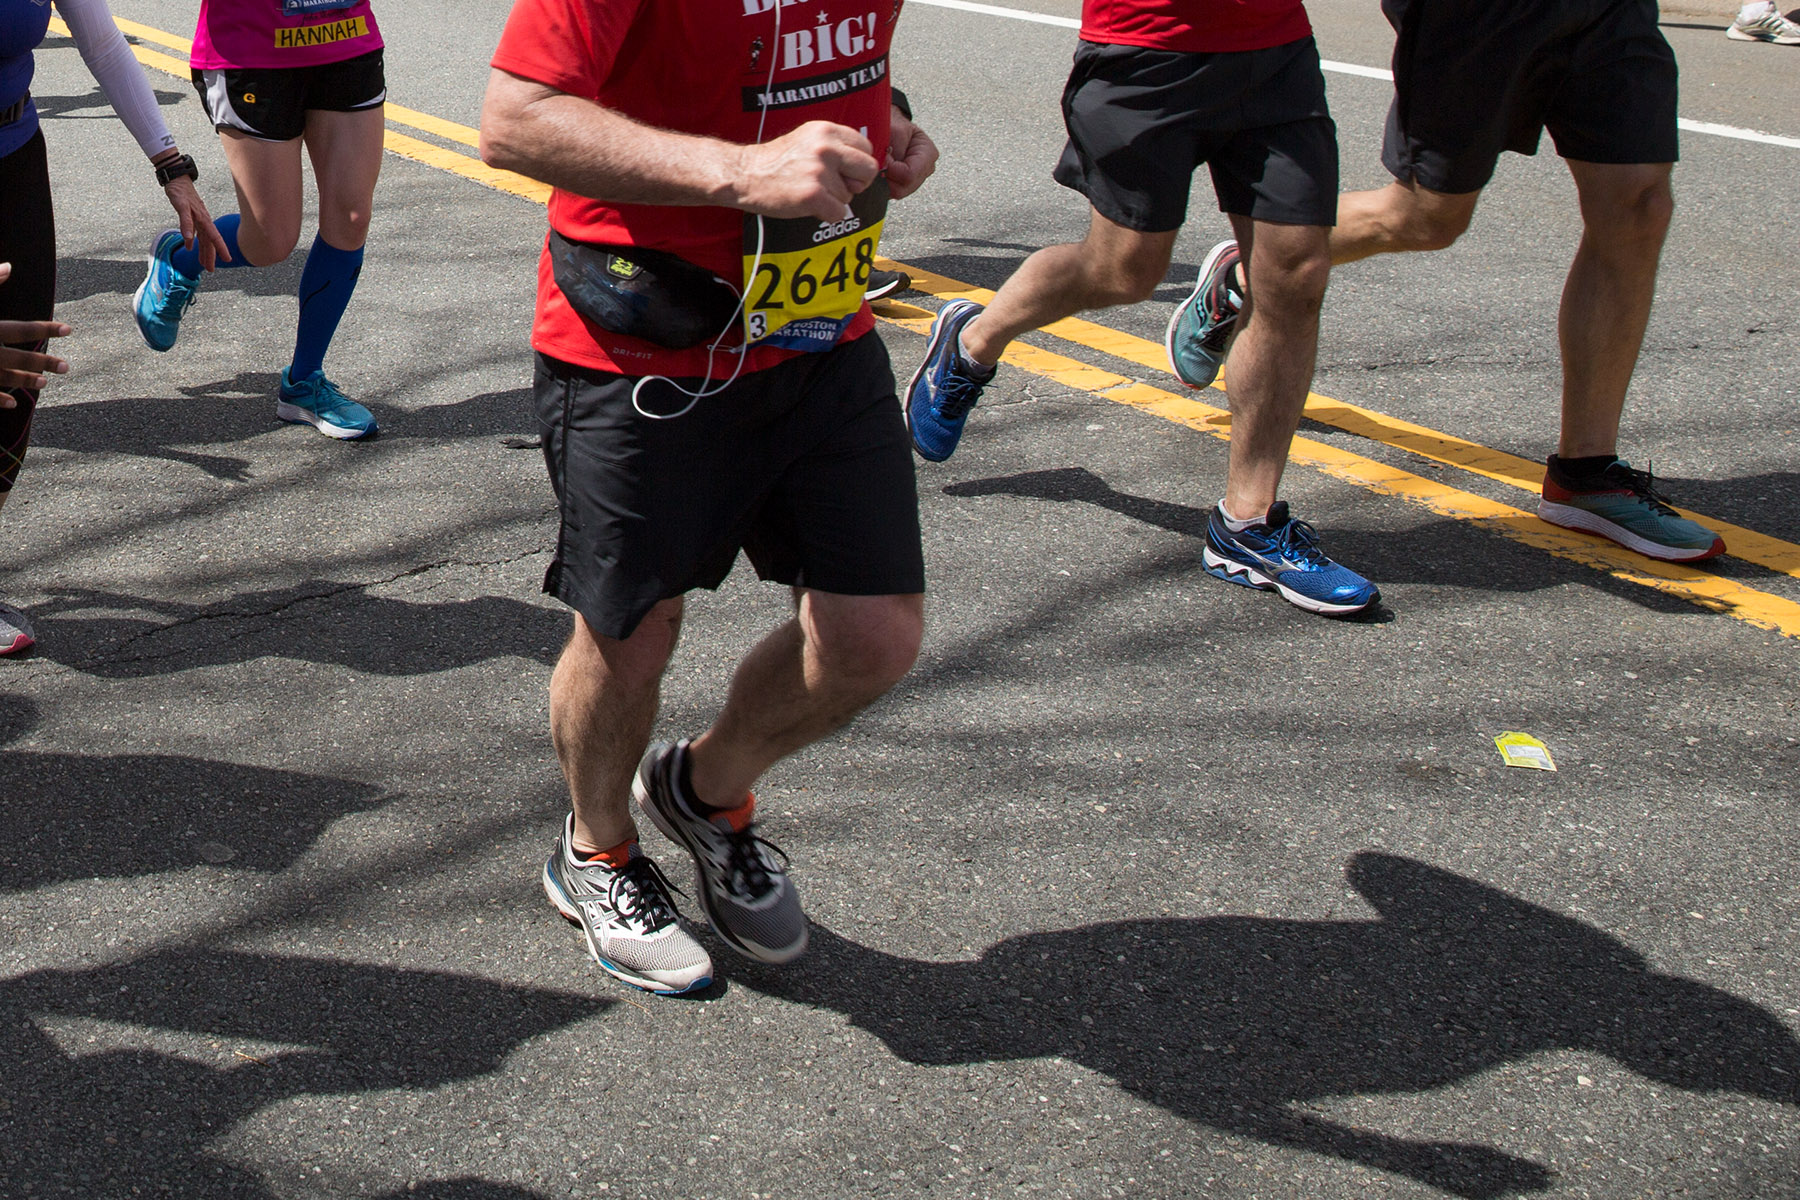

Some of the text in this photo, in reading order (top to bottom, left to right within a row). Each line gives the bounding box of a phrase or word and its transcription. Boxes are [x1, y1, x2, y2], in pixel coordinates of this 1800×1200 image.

[281, 18, 359, 47] HANNAH
[781, 10, 877, 71] BIG!
[758, 59, 887, 107] MARATHON TEAM
[812, 217, 861, 243] adidas
[752, 237, 873, 311] 2648
[750, 314, 766, 338] 3
[775, 329, 835, 341] ARATHON
[612, 346, 653, 361] DRI-FIT
